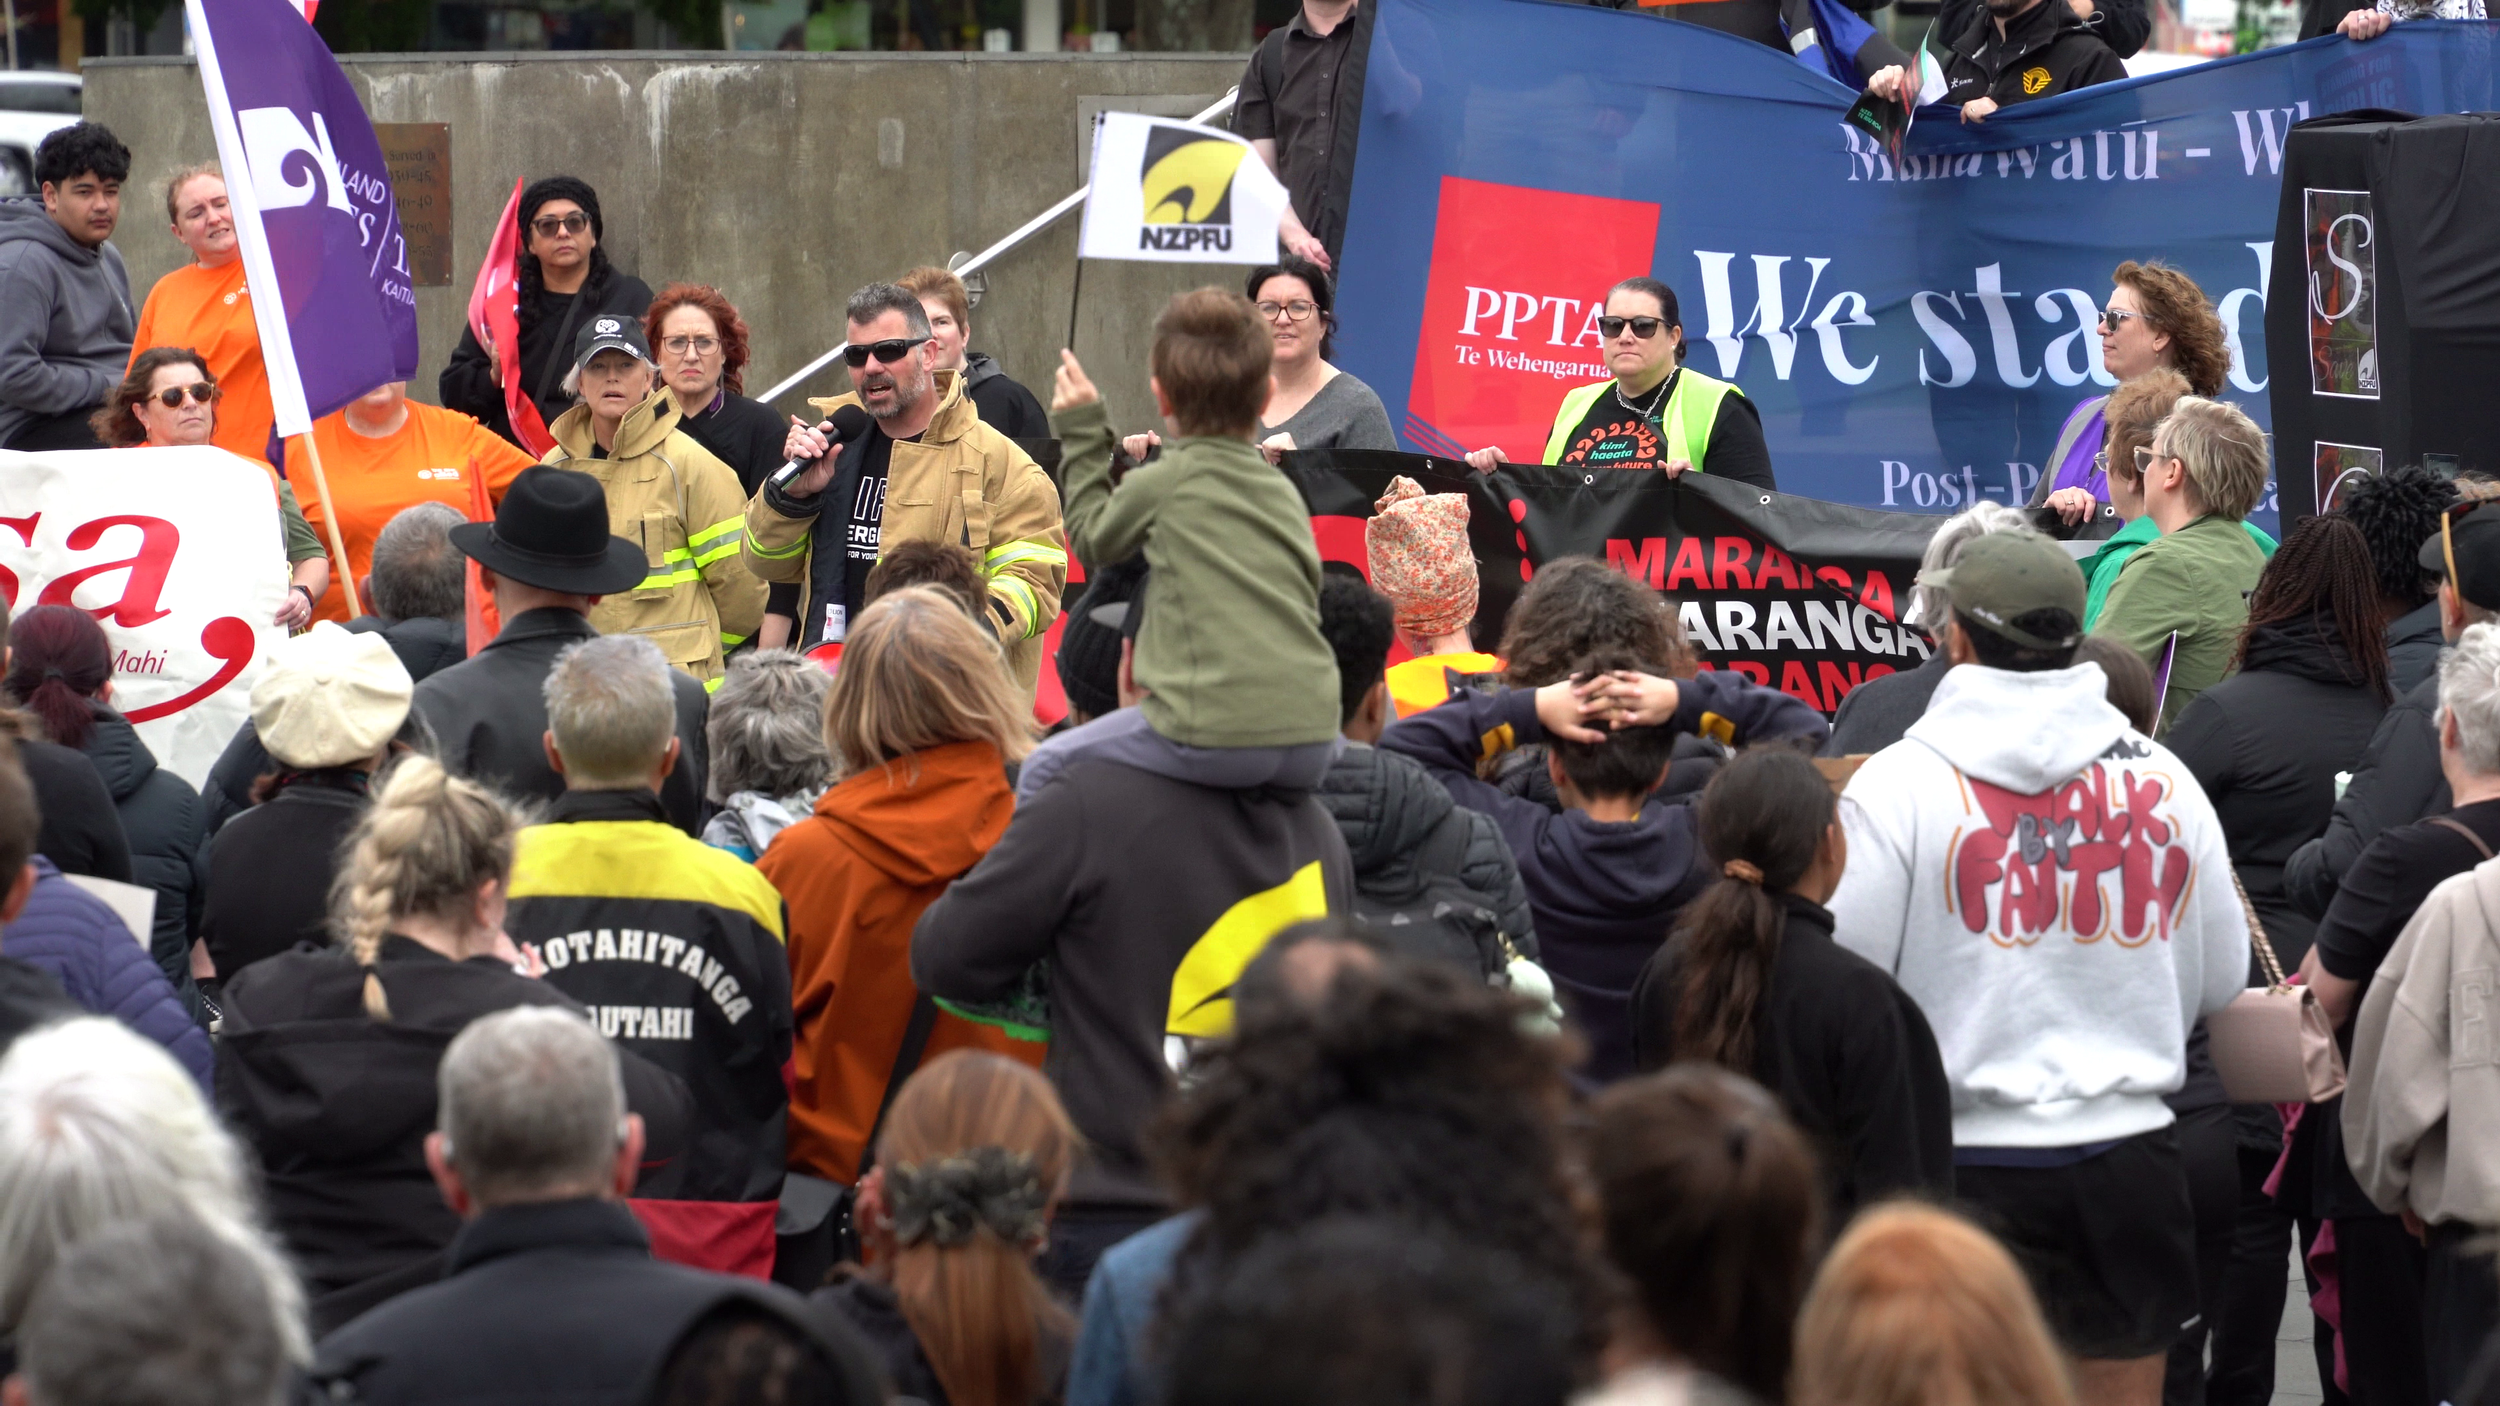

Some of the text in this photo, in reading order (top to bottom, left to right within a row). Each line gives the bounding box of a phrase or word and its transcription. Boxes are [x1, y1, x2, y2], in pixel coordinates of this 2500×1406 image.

[389, 151, 422, 162] Served
[1139, 227, 1232, 251] NZPFU
[1458, 286, 1604, 349] PPTA
[1693, 240, 2275, 394] We stad
[1455, 345, 1612, 380] Te Wehengarua
[1590, 448, 1633, 460] haeata
[1599, 441, 1628, 450] kimi
[1879, 460, 2043, 508] Post-P
[848, 551, 878, 560] FOR YOUR
[1660, 598, 1932, 661] ARANGA
[1967, 761, 2171, 847] WALK
[2018, 812, 2075, 867] BY
[1957, 826, 2190, 942] FAITH
